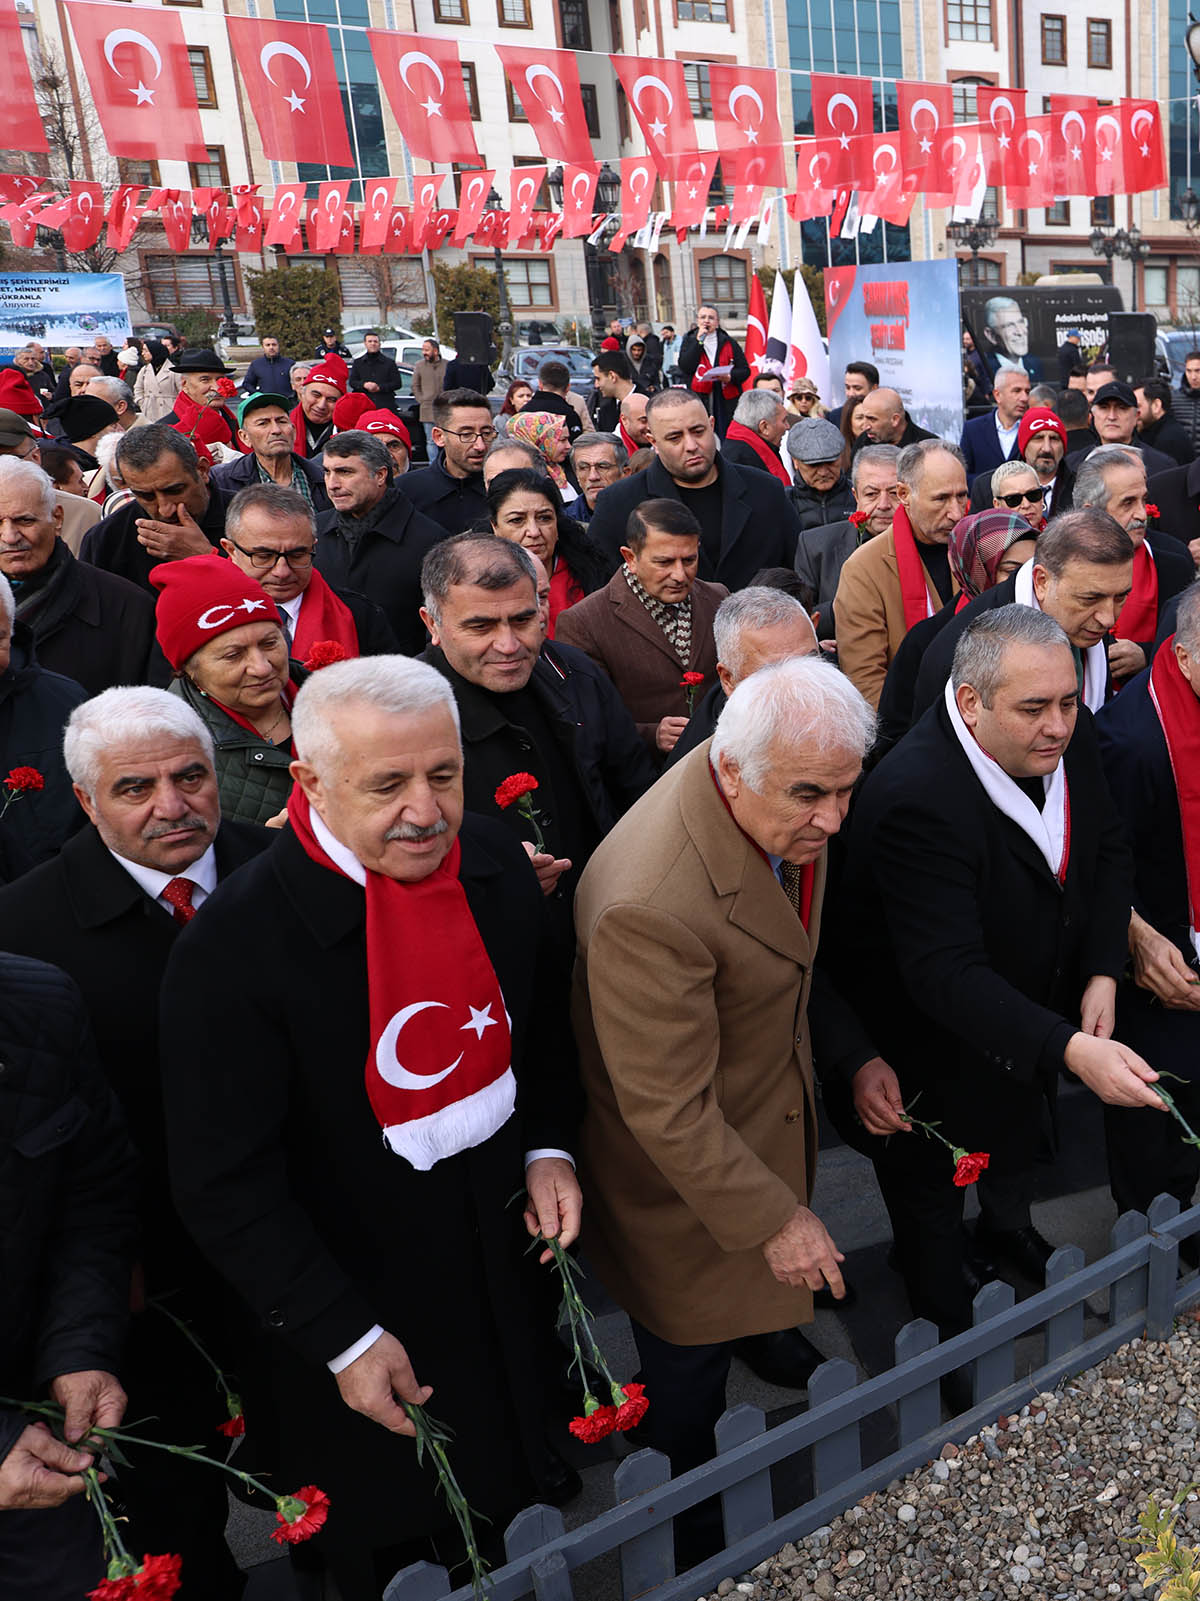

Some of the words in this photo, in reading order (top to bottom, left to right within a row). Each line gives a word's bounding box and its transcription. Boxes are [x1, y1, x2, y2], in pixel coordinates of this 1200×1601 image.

[10, 277, 70, 286] ŞEHİTLERİMİZİ
[15, 285, 46, 293] MİNNET
[2, 301, 40, 310] Anıyoruz
